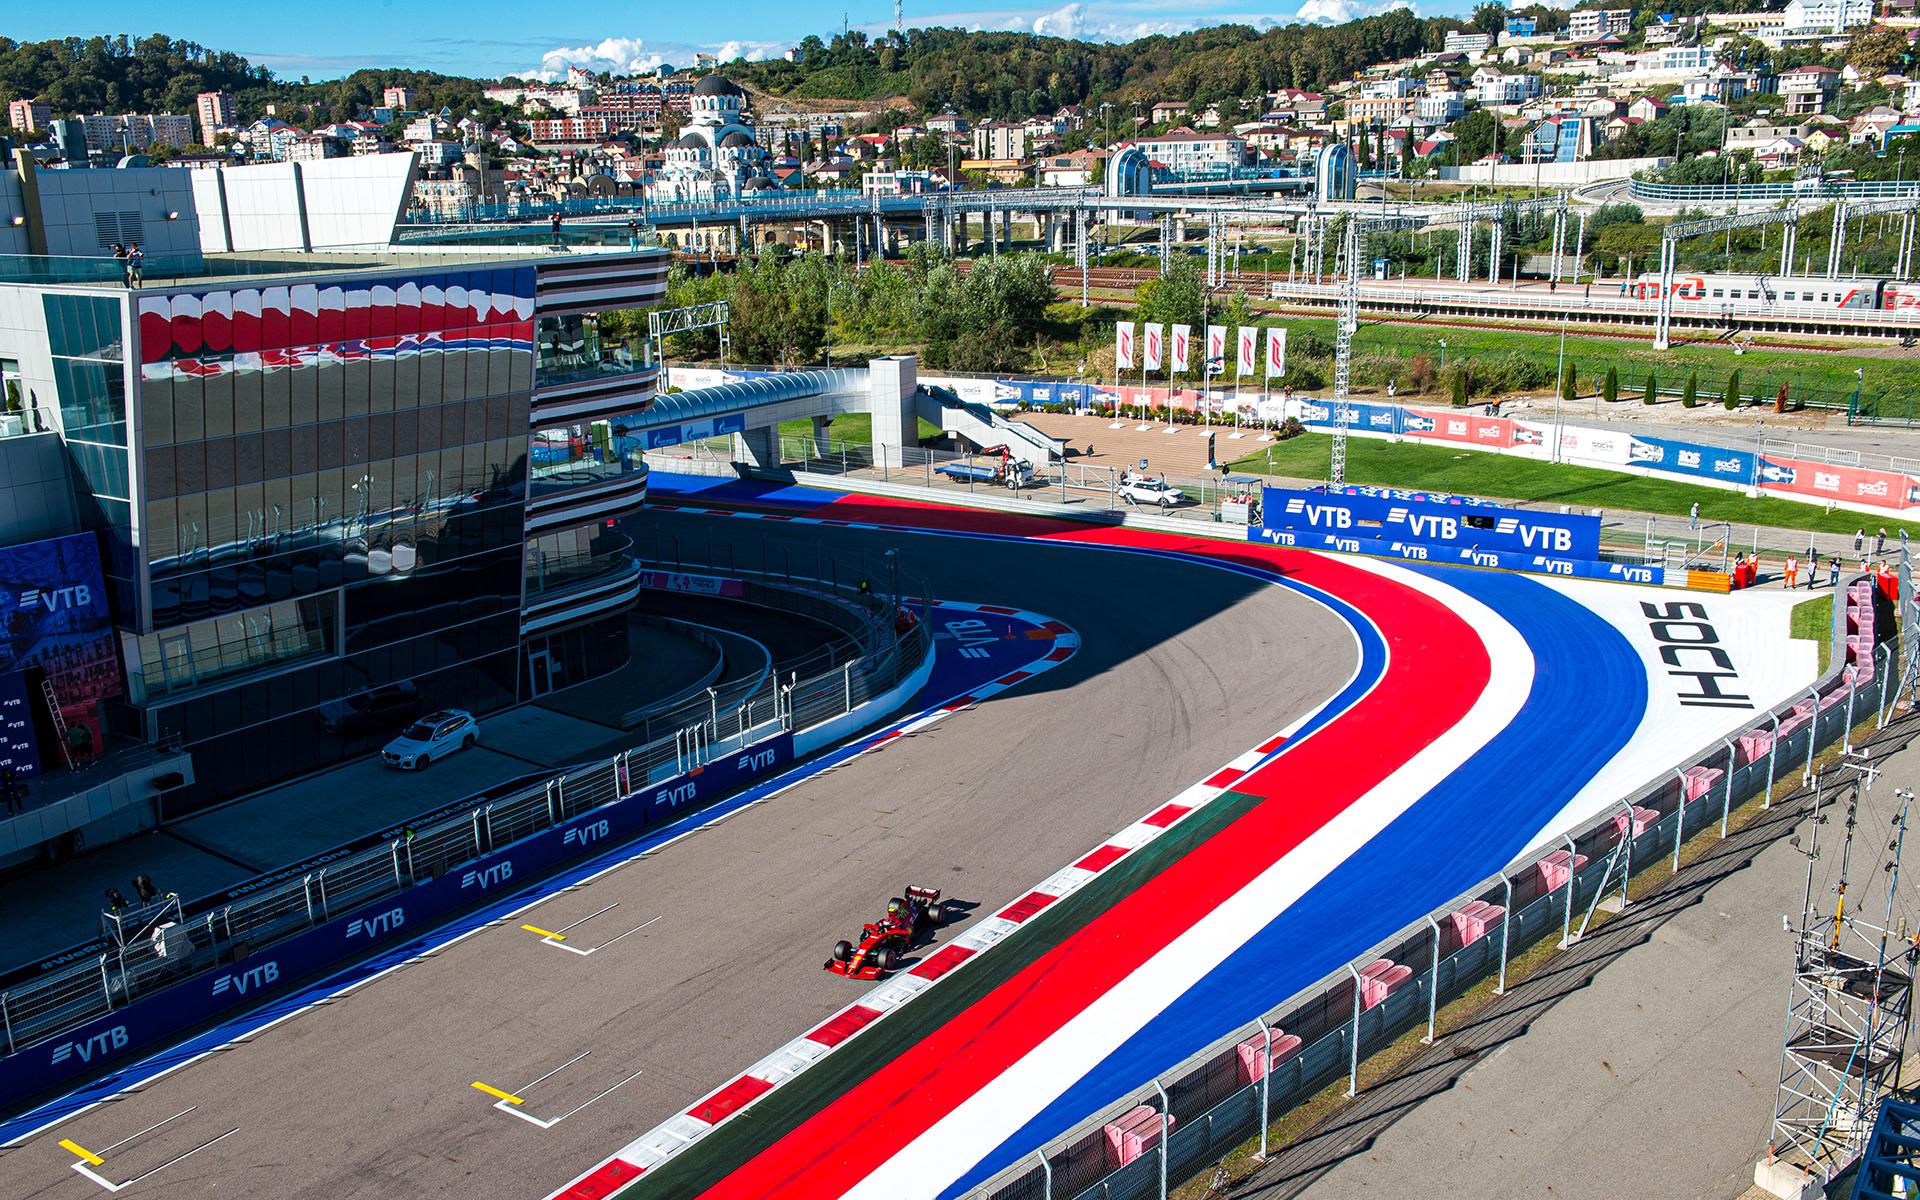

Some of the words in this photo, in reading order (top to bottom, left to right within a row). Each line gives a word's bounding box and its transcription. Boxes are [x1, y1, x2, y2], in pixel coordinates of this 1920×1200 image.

[1306, 504, 1351, 529] VTB
[1408, 513, 1457, 540] VTB
[1272, 532, 1295, 546] VTB
[1335, 538, 1360, 552] VTB
[1518, 525, 1572, 551] VTB
[1401, 545, 1427, 560] VTB
[1472, 550, 1498, 567] VTB
[1545, 560, 1573, 575] VTB
[1623, 567, 1652, 583] VTB
[42, 585, 92, 612] VTB
[944, 619, 1000, 648] VTB
[1640, 601, 1755, 709] SOCHI
[8, 698, 21, 706] VTB
[12, 720, 25, 728] VTB
[16, 742, 29, 750] VTB
[21, 763, 33, 771] VTB
[749, 748, 775, 771] VTB
[668, 781, 697, 806] VTB
[577, 819, 610, 845] VTB
[227, 849, 351, 898] #WeRaceAsOne
[476, 860, 513, 889] VTB
[365, 906, 405, 938] VTB
[232, 960, 279, 994] VTB
[75, 1025, 129, 1062] VTB
